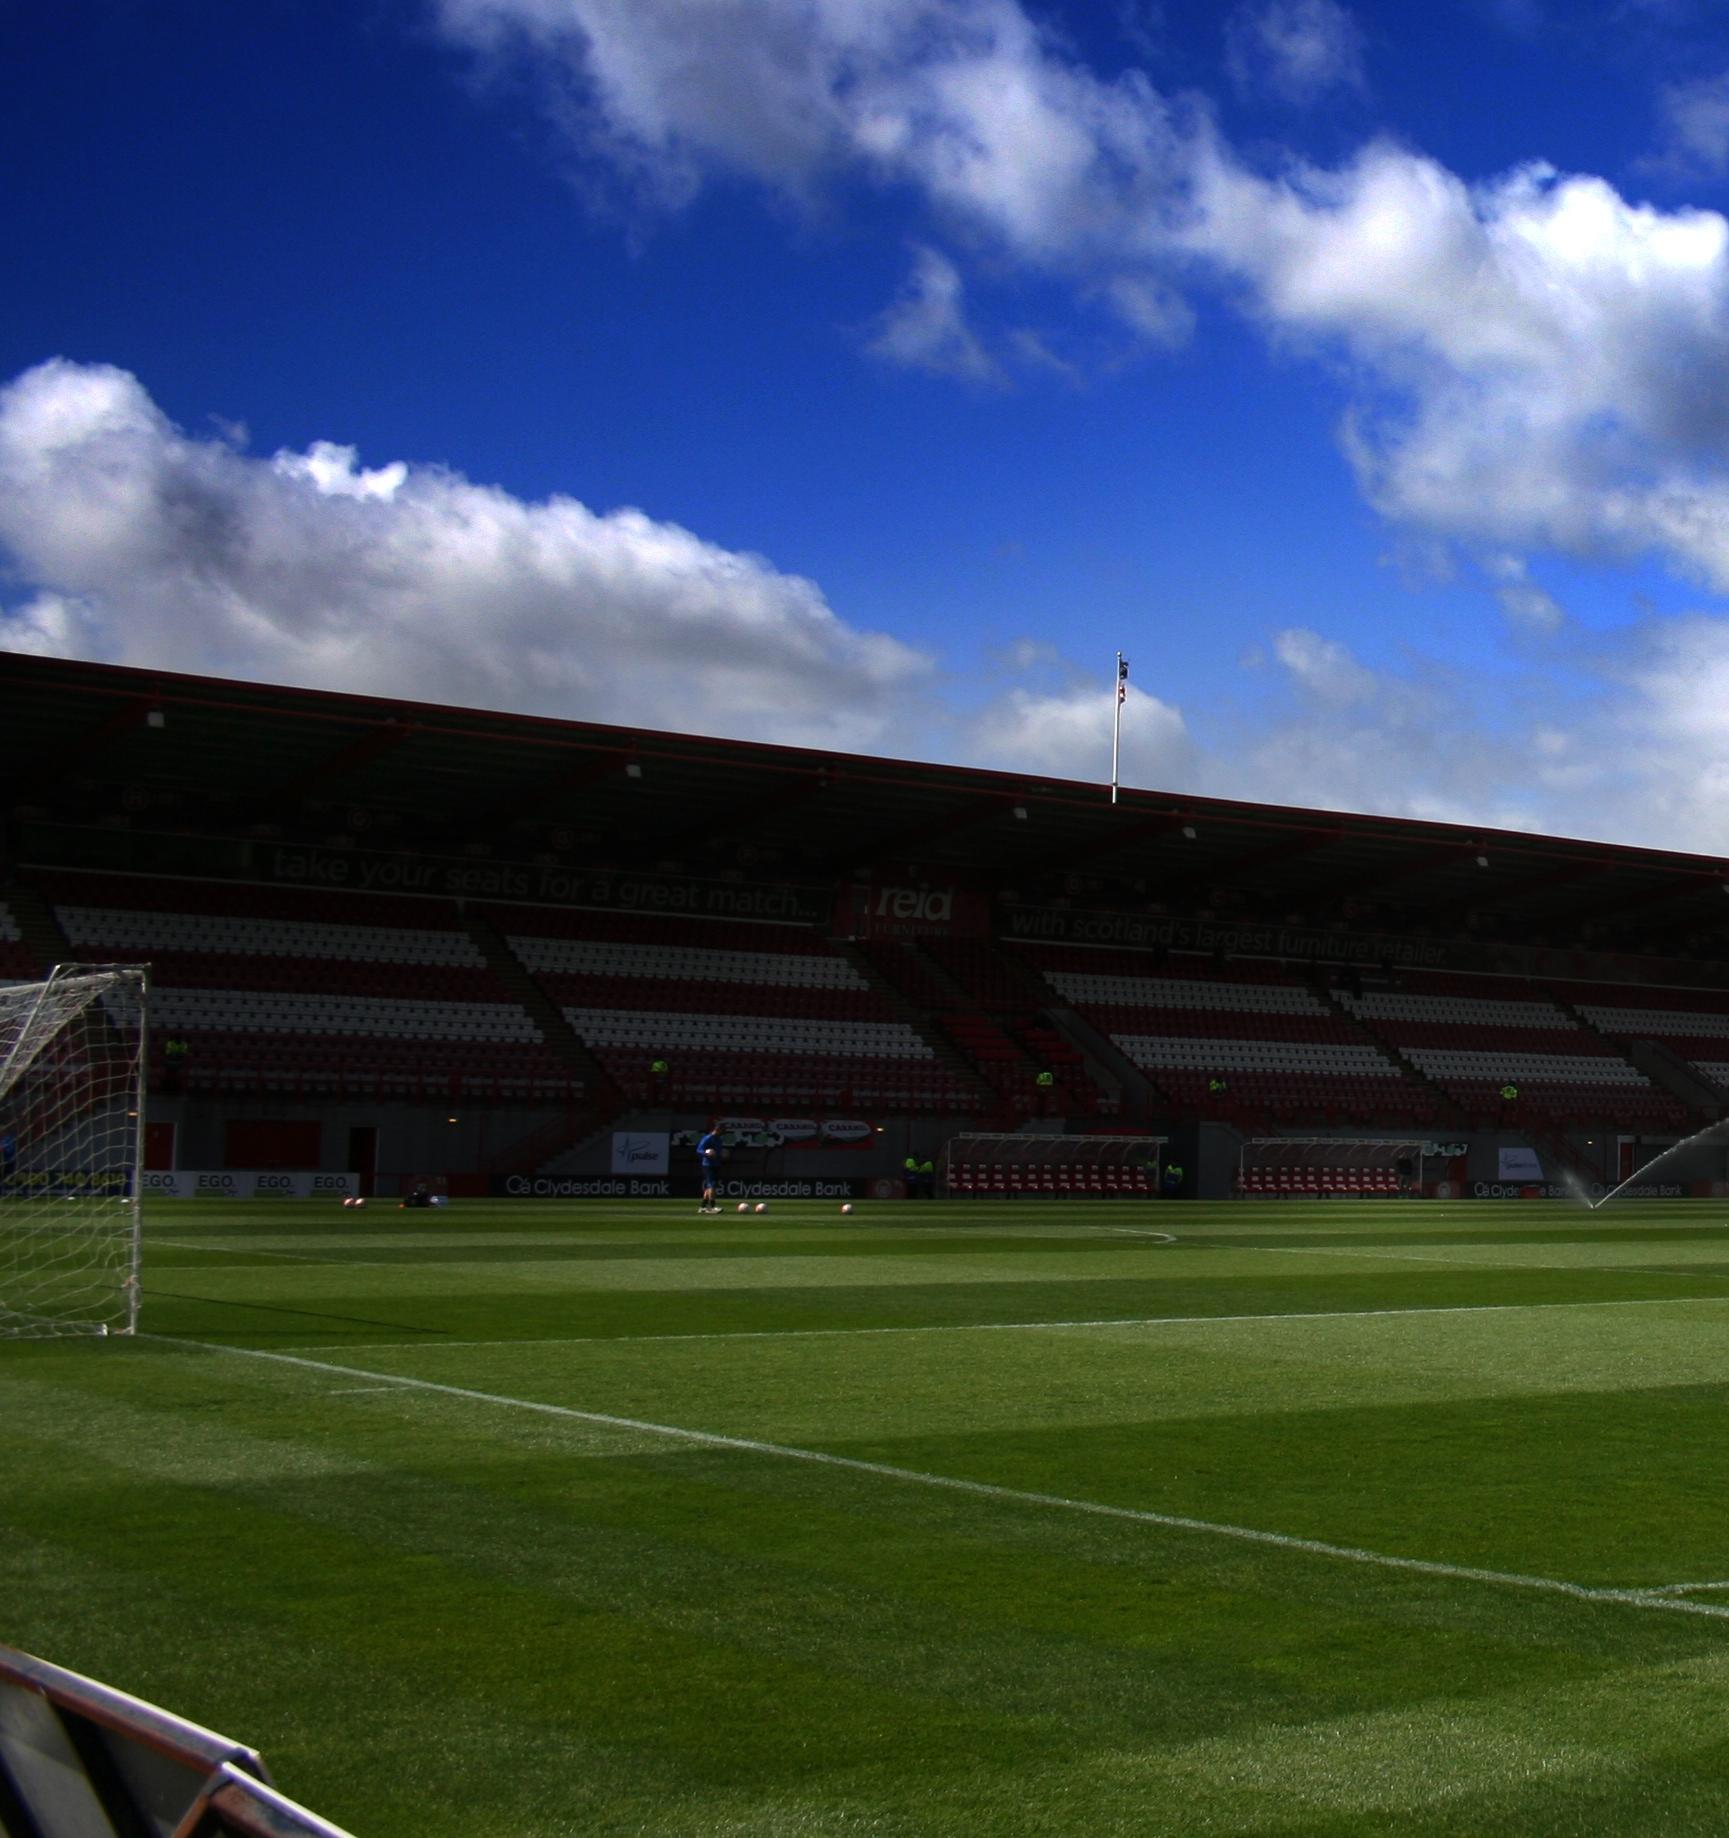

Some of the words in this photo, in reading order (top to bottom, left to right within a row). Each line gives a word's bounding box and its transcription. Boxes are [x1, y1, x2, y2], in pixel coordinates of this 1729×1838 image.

[272, 850, 350, 880] take
[359, 861, 436, 889] your
[445, 865, 528, 895] seats
[538, 871, 583, 899] for
[592, 881, 610, 901] a
[618, 880, 701, 909] great
[875, 882, 956, 921] reid
[1010, 911, 1065, 937] with
[1071, 916, 1191, 946] scotland's
[1195, 923, 1273, 953] largest
[1279, 928, 1369, 959] furniture
[534, 1177, 625, 1197] Clydesdale
[630, 1179, 670, 1195] Bank
[727, 1180, 812, 1198] Clydesdale
[815, 1181, 852, 1195] Bank
